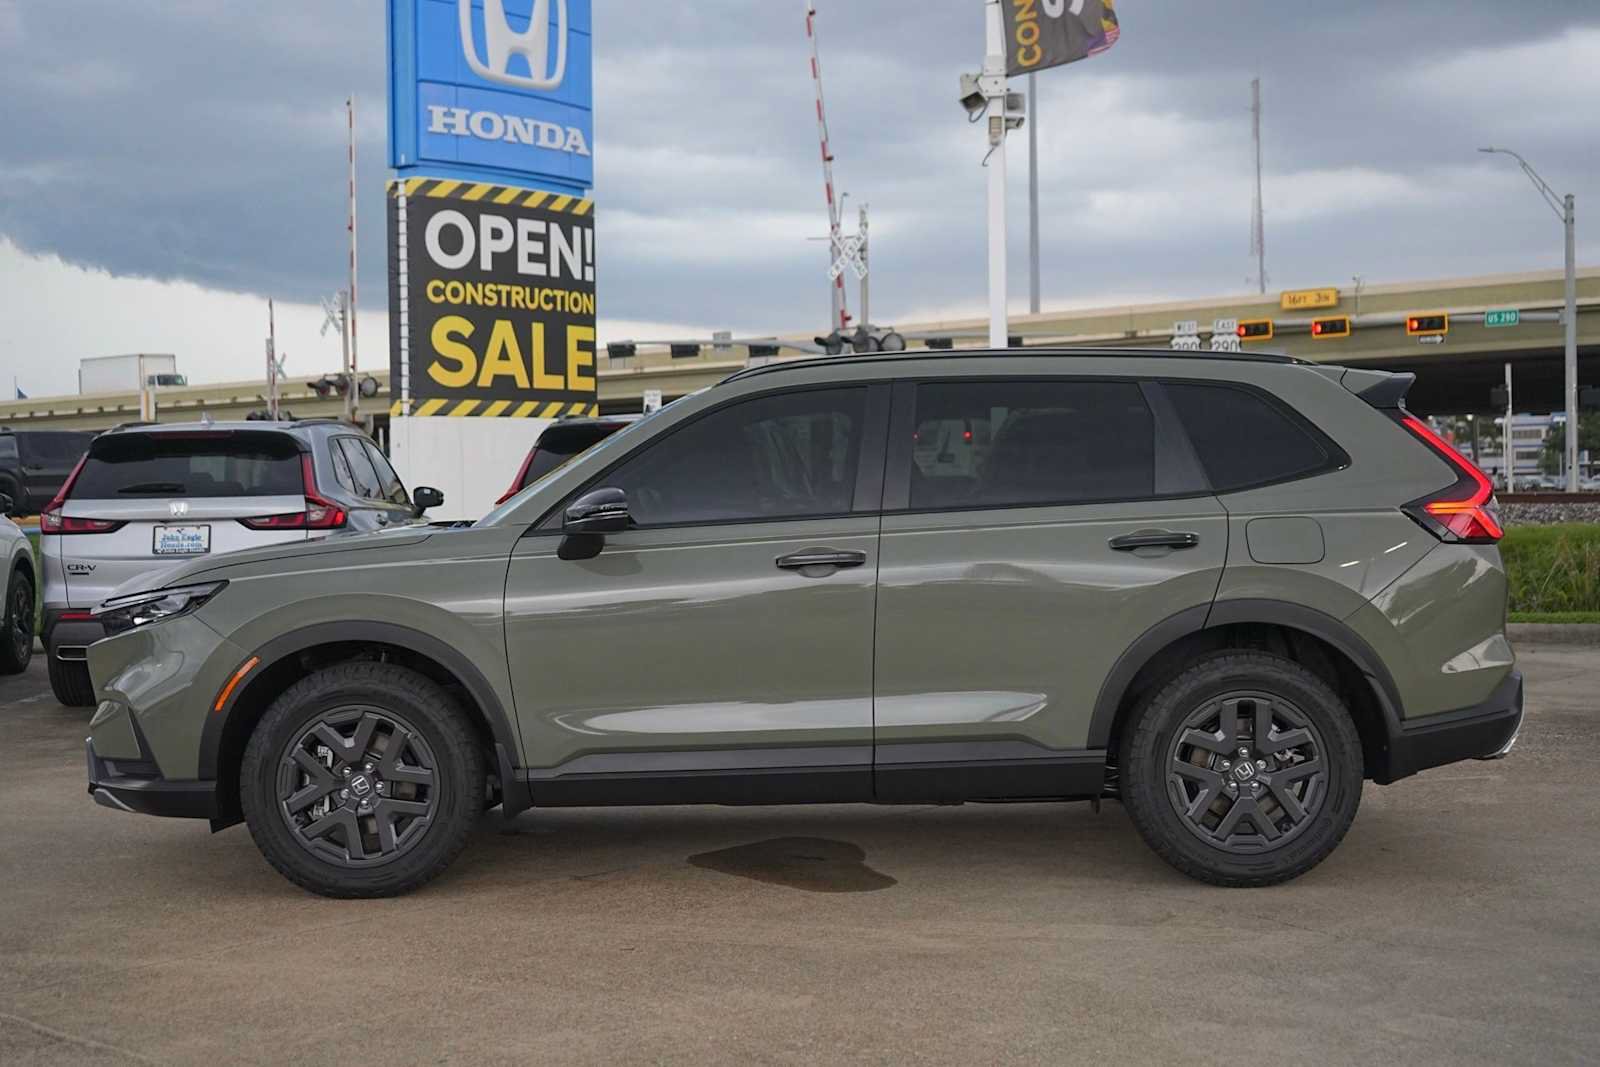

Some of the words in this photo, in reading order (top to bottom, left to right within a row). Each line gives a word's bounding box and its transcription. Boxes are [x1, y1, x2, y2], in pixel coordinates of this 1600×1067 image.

[427, 105, 591, 156] HONDA
[425, 209, 594, 282] OPEN!
[426, 279, 594, 314] CONSTRUCTION
[1487, 313, 1498, 323] US
[427, 315, 596, 392] SALE
